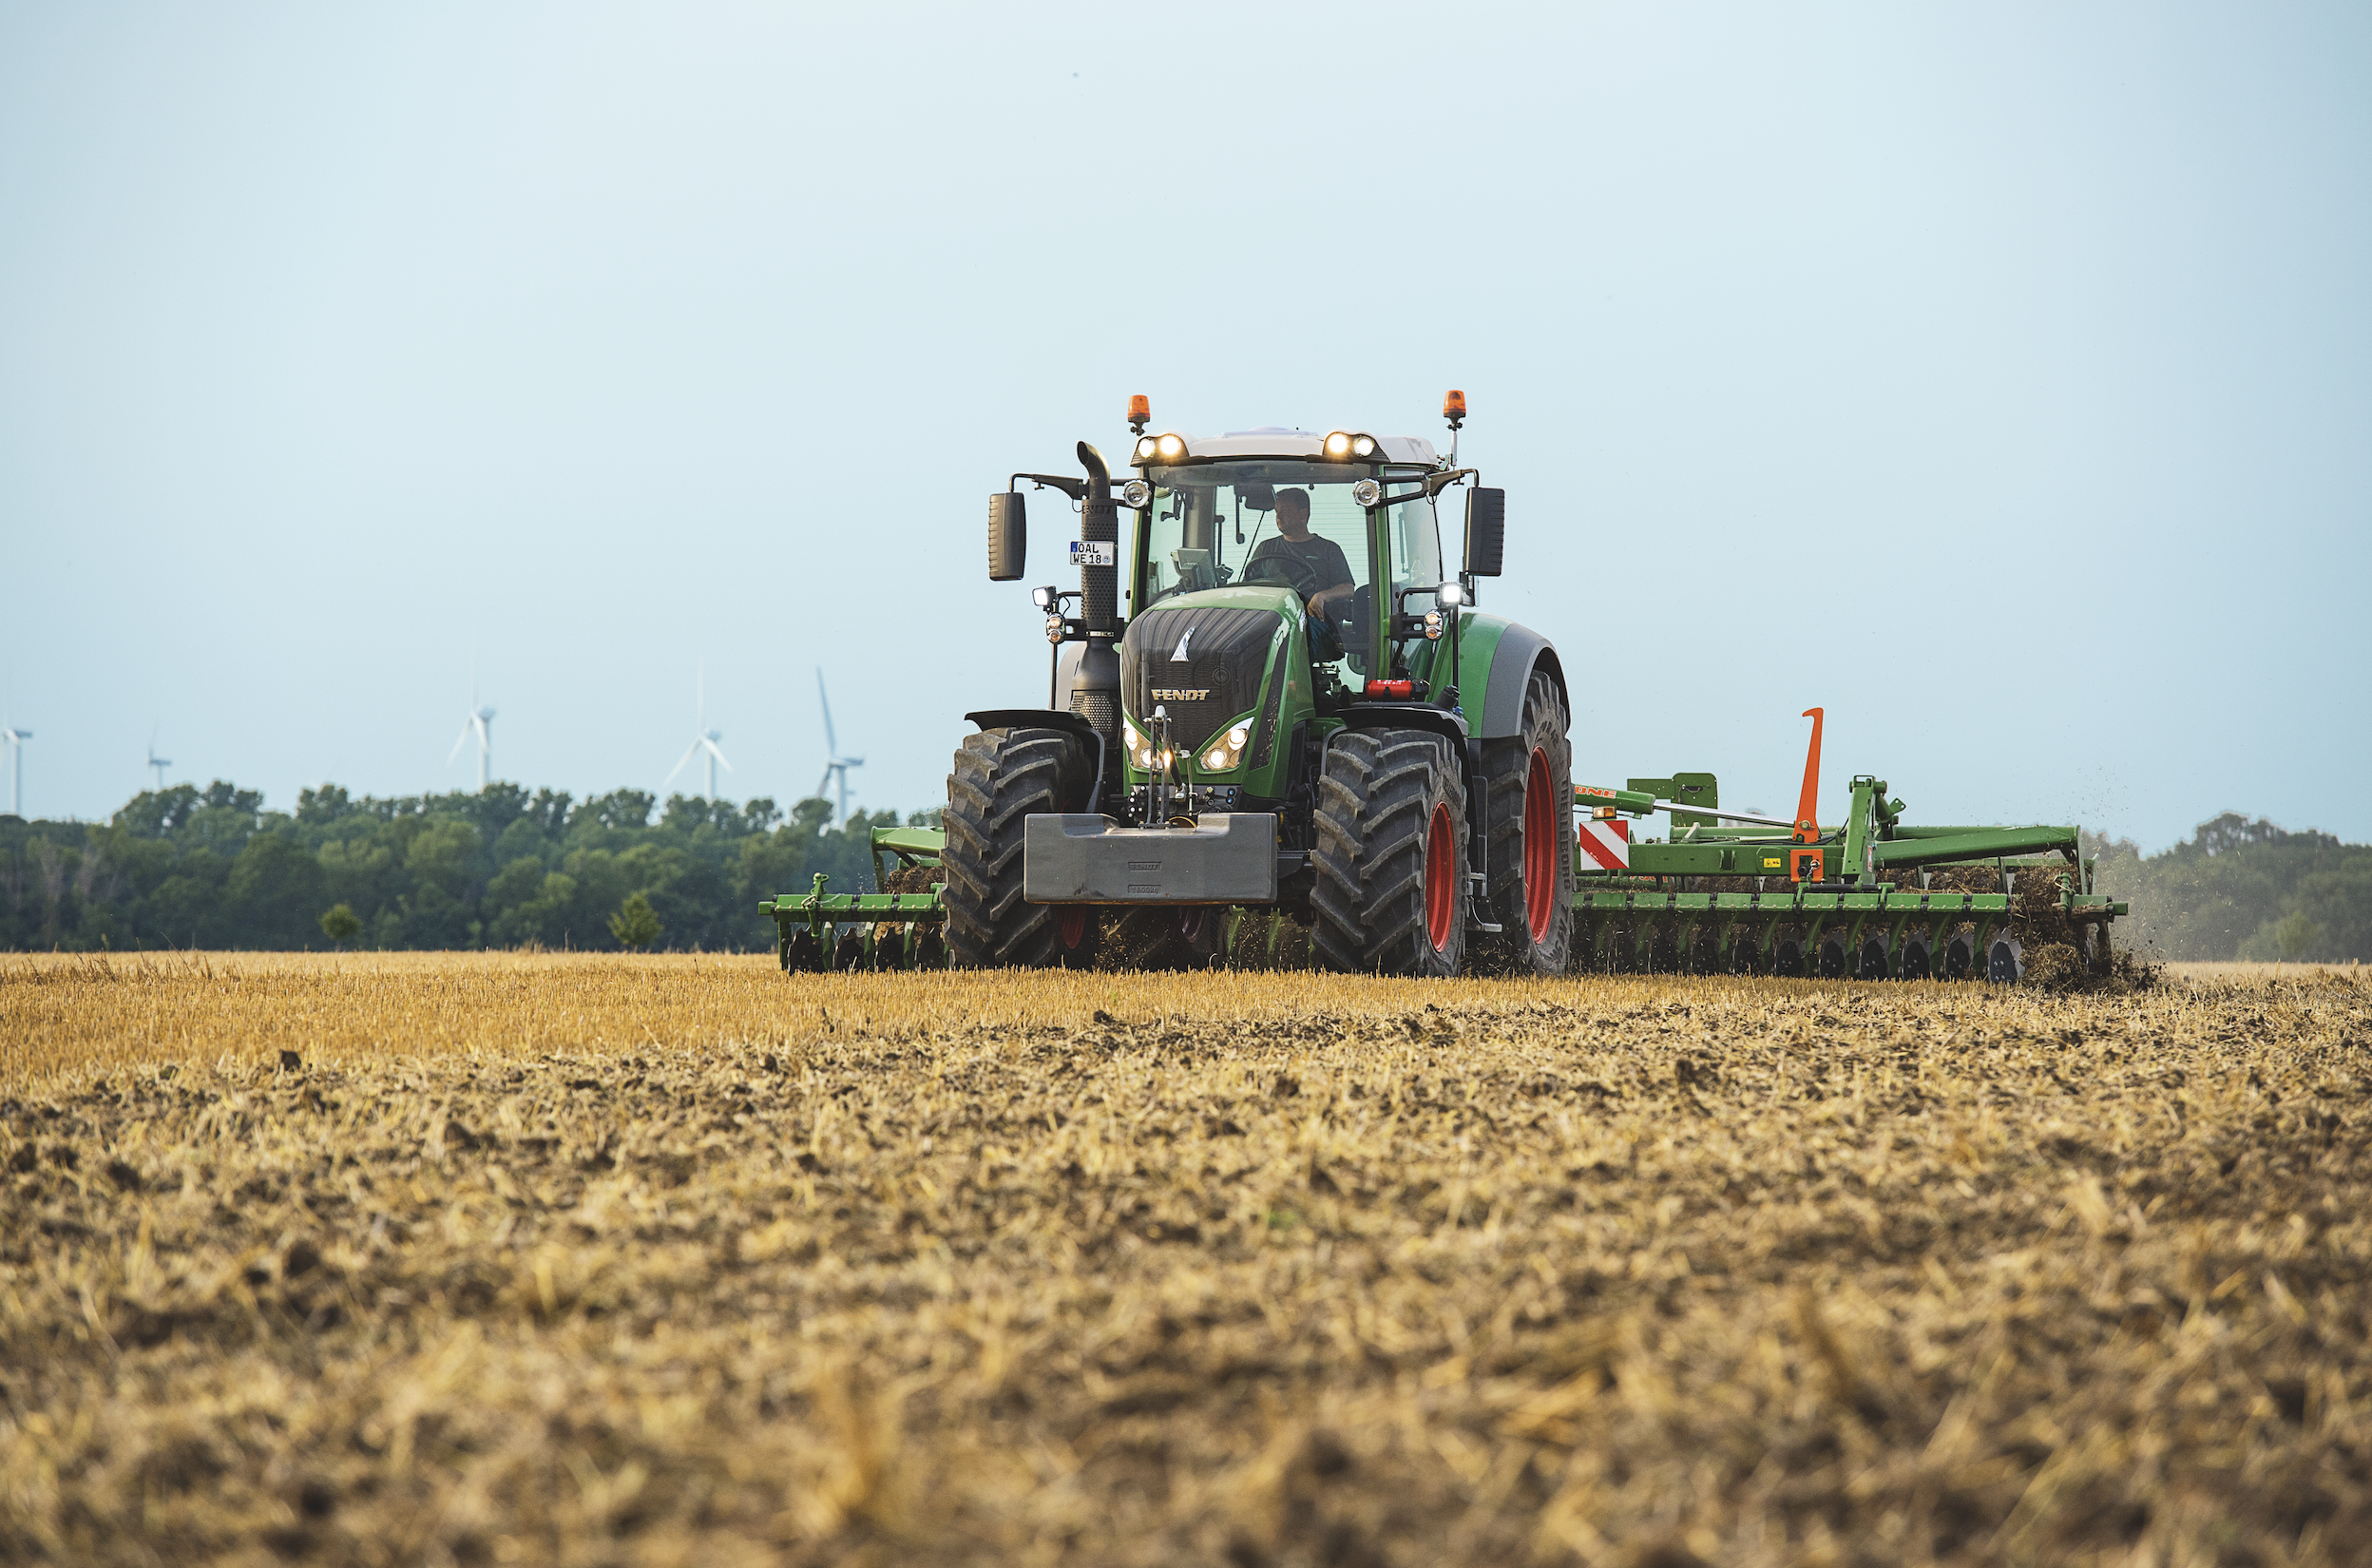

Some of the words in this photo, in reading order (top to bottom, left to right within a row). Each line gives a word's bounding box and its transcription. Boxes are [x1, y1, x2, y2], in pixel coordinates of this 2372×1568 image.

[1078, 543, 1099, 553] OAL
[1073, 553, 1086, 564] WE
[1088, 554, 1101, 564] 18
[1151, 689, 1210, 701] FENDT
[1559, 775, 1571, 890] TRELLEBORG
